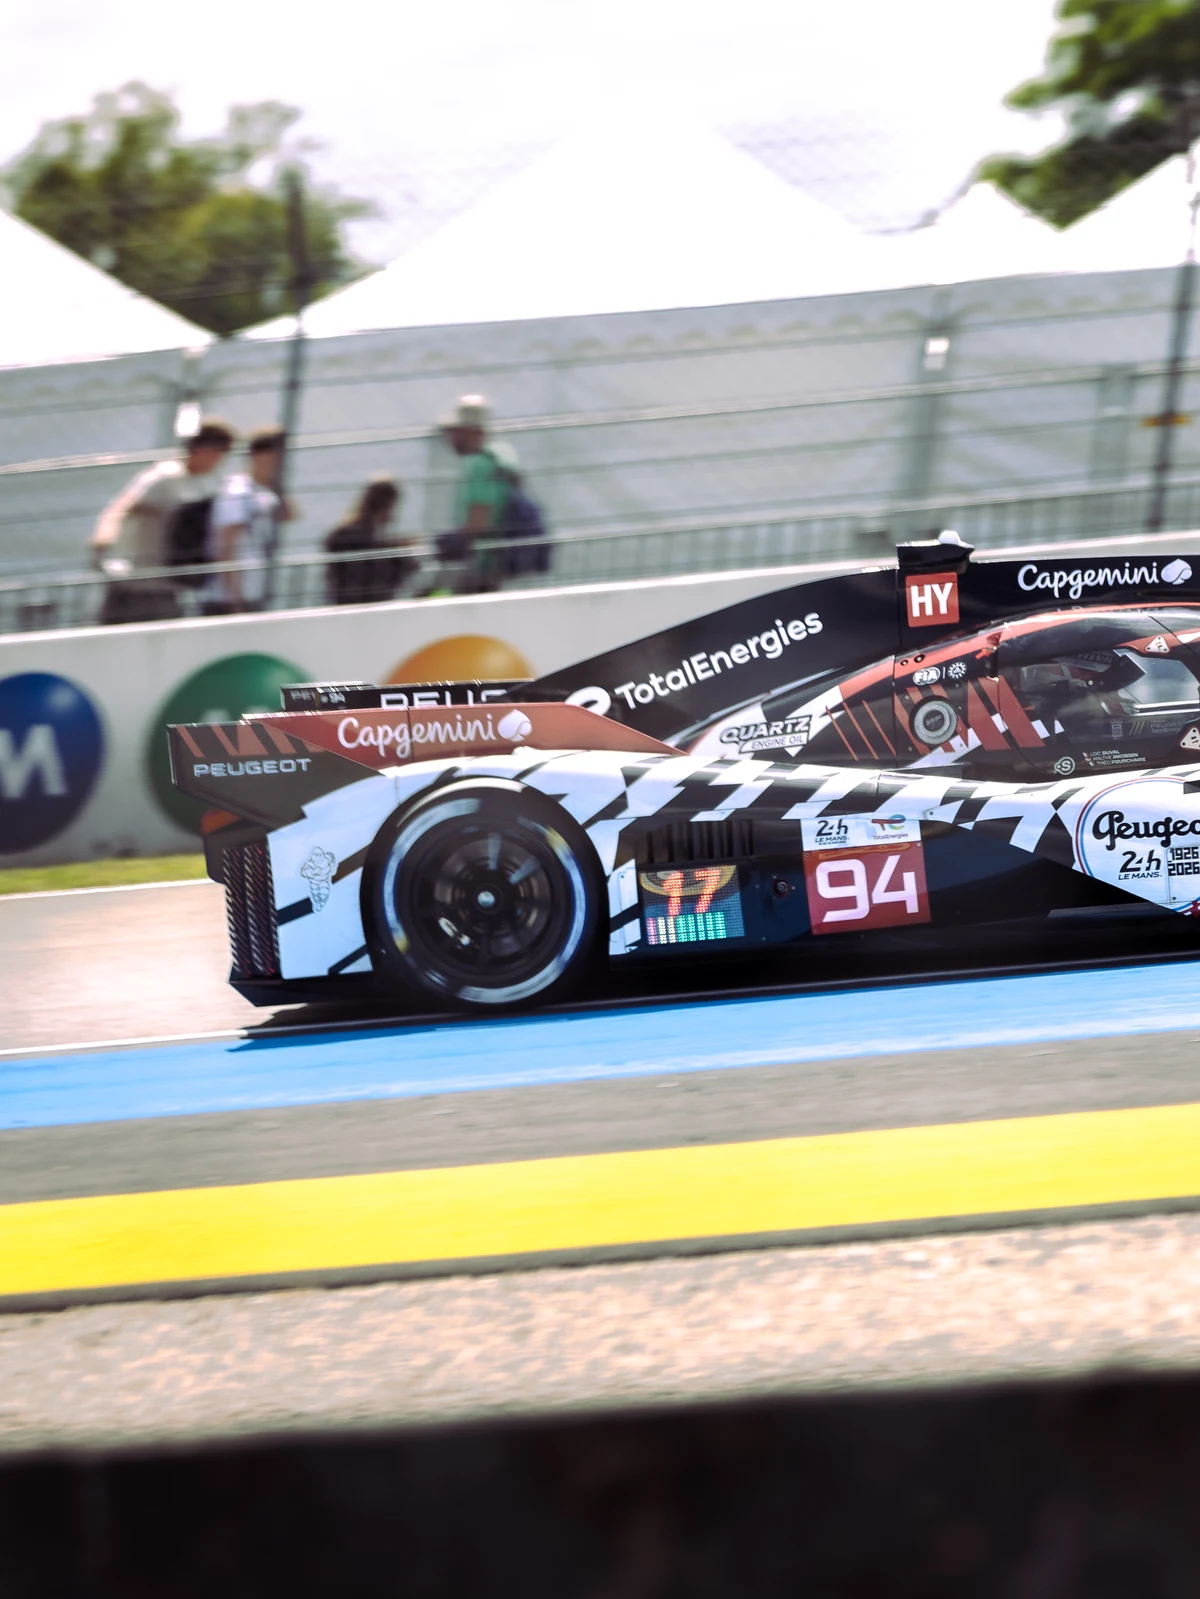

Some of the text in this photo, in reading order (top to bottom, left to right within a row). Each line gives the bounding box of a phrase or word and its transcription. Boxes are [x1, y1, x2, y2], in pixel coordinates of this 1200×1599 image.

[1017, 562, 1160, 600] Capgemini
[909, 582, 954, 618] HY
[614, 612, 824, 710] TotalEnergies
[914, 668, 939, 682] FIA
[337, 712, 496, 758] Capgemini
[719, 714, 813, 744] QUARTZ
[751, 734, 805, 750] ENGINE OIL
[193, 757, 313, 778] PEUGEOT
[1111, 757, 1147, 765] POURCHAIRE
[815, 818, 849, 837] 24h
[1119, 849, 1162, 873] 24h
[1169, 846, 1200, 861] 1926
[1131, 871, 1160, 879] MANS
[1167, 861, 1200, 877] 2026
[662, 868, 722, 917] 17
[815, 855, 920, 923] 94
